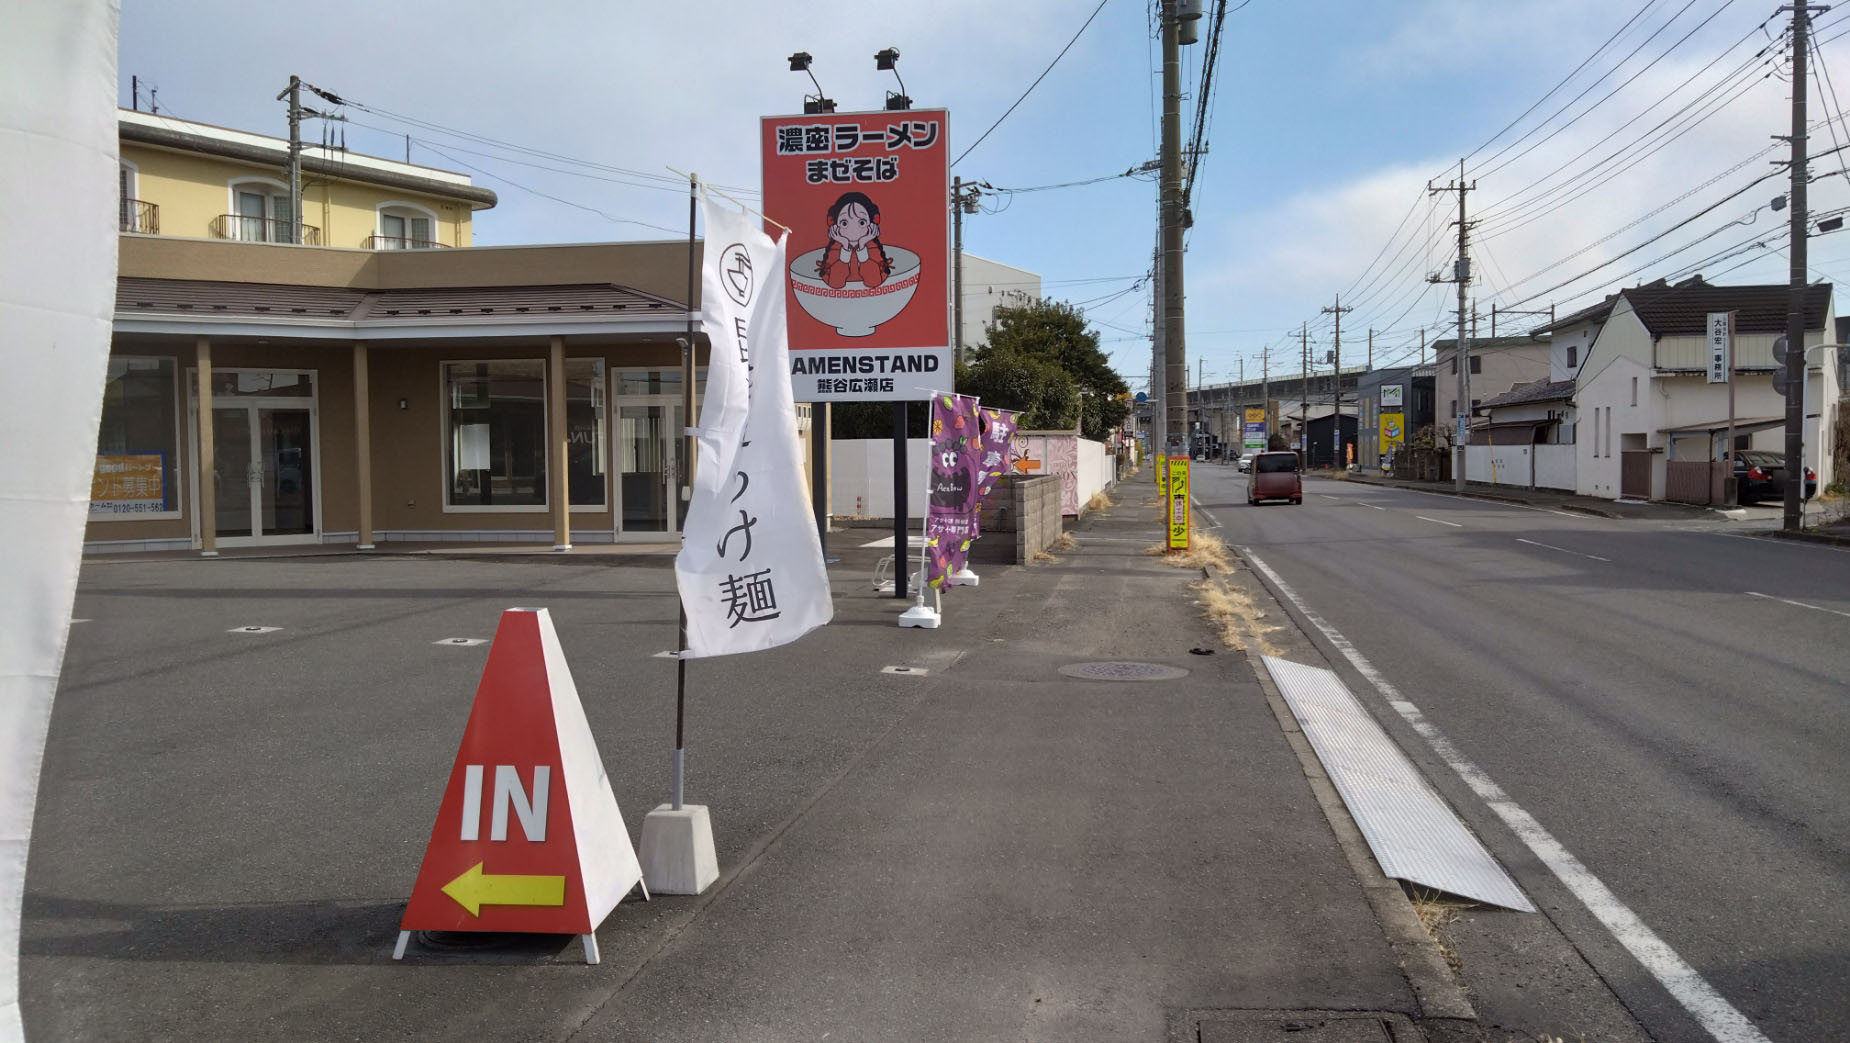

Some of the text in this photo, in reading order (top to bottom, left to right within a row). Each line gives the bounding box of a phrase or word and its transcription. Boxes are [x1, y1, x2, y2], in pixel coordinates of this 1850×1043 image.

[777, 122, 938, 154] 濃密ラーメン
[806, 156, 898, 184] まぜそば
[1714, 318, 1722, 380] 大谷宏一事務所
[792, 354, 939, 376] AMENSTAND
[817, 377, 894, 394] 熊谷広瀬店
[92, 474, 161, 497] ント募集中
[460, 764, 550, 842] IN
